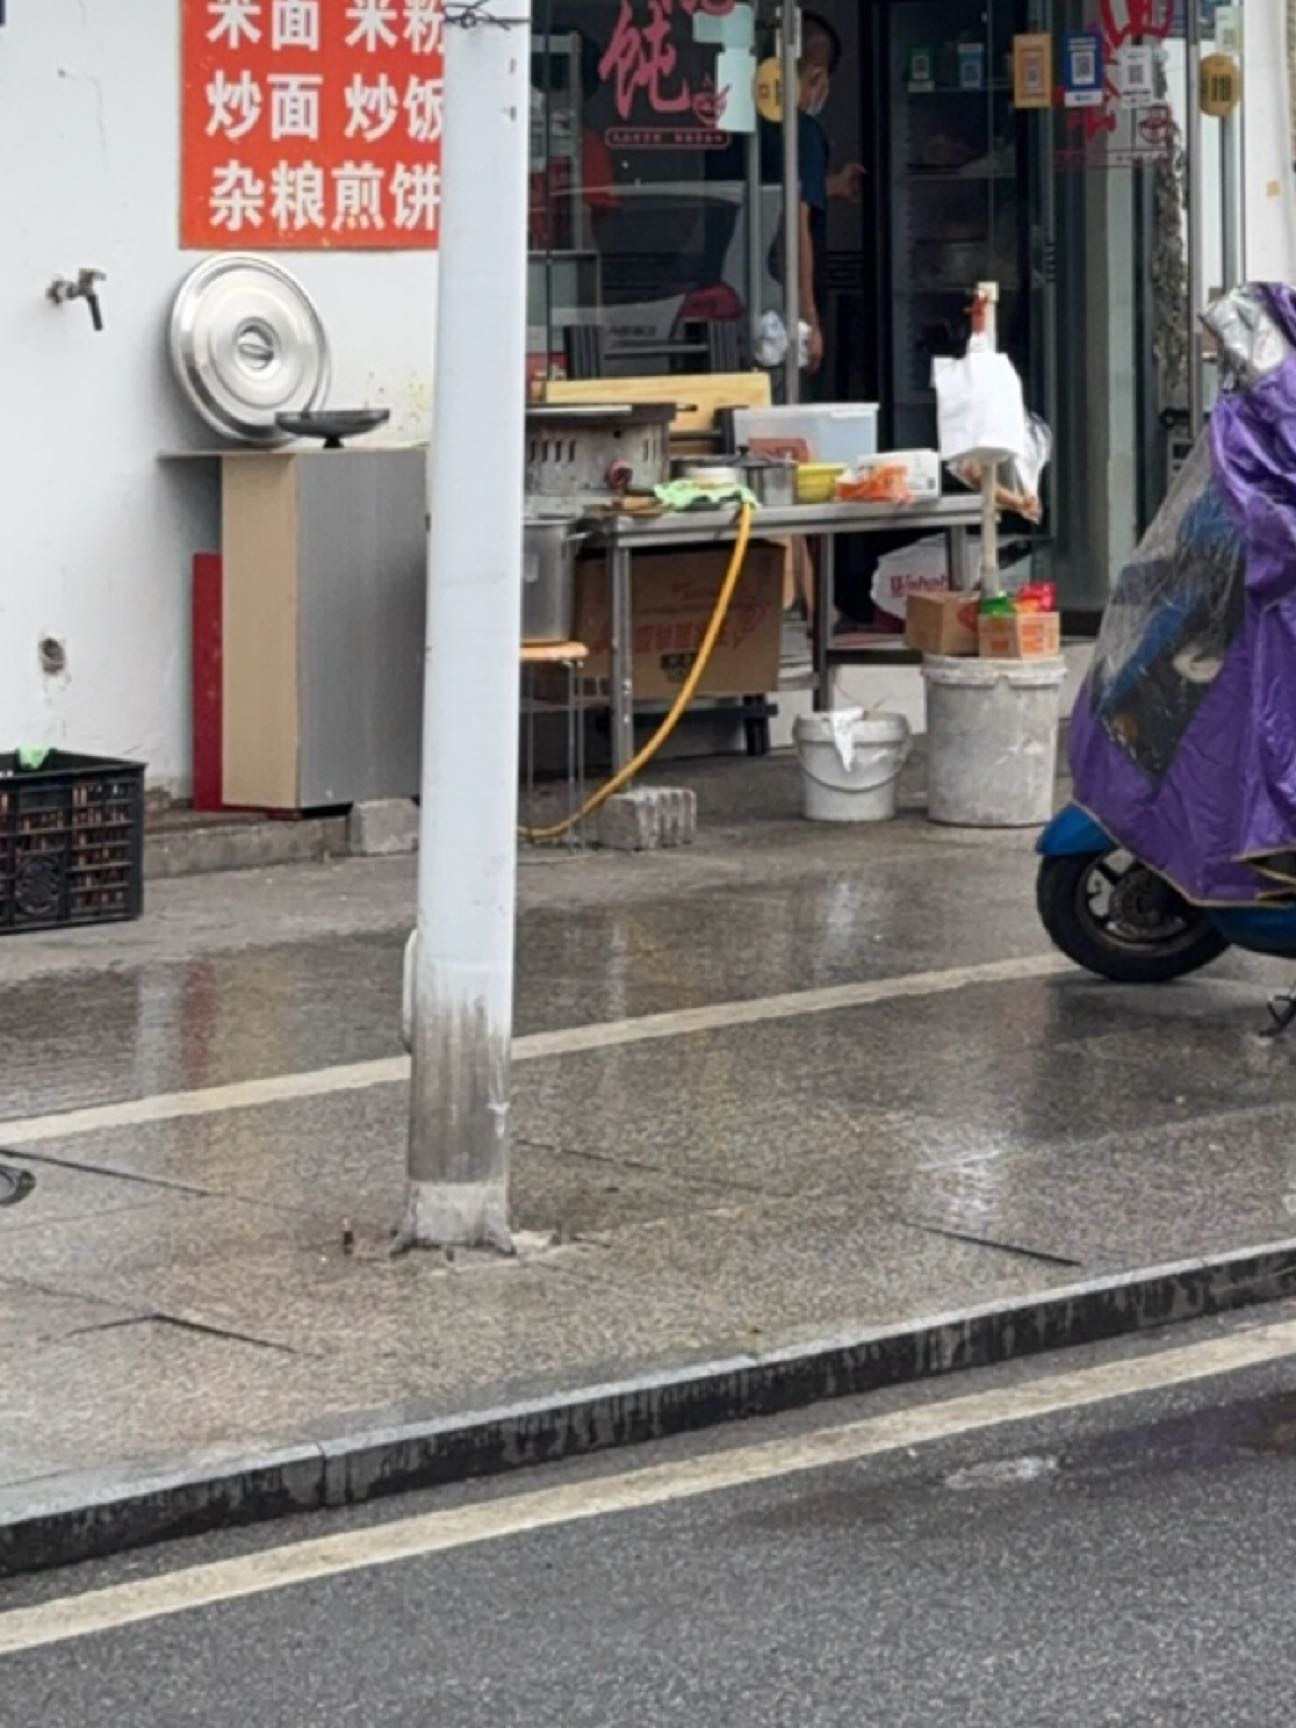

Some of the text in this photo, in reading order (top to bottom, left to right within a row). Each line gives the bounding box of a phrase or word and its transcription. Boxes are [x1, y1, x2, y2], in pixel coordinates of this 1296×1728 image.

[206, 69, 443, 143] 炒面 炒饭
[208, 158, 441, 233] 杂粮煎饼
